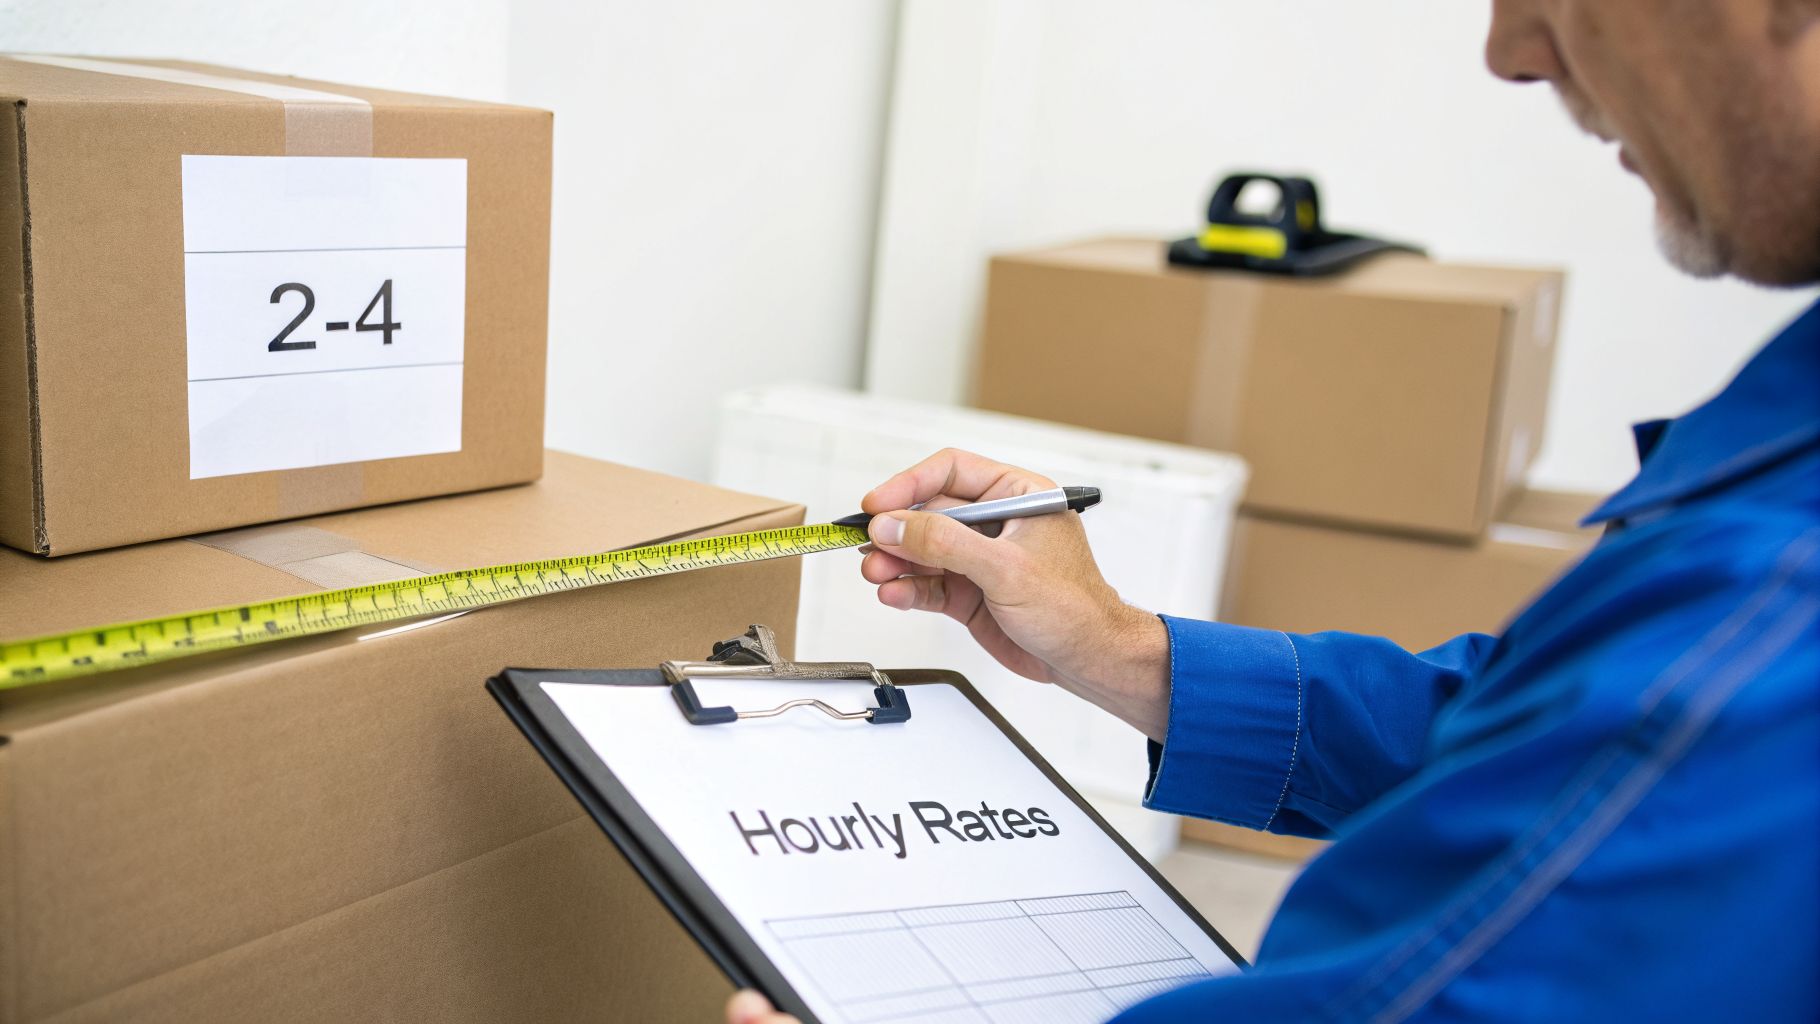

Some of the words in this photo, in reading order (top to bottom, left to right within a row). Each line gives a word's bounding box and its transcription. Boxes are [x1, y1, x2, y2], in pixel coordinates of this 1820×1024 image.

[267, 279, 402, 353] 2-4
[729, 801, 907, 859] Hourly
[908, 801, 1061, 844] Rates
